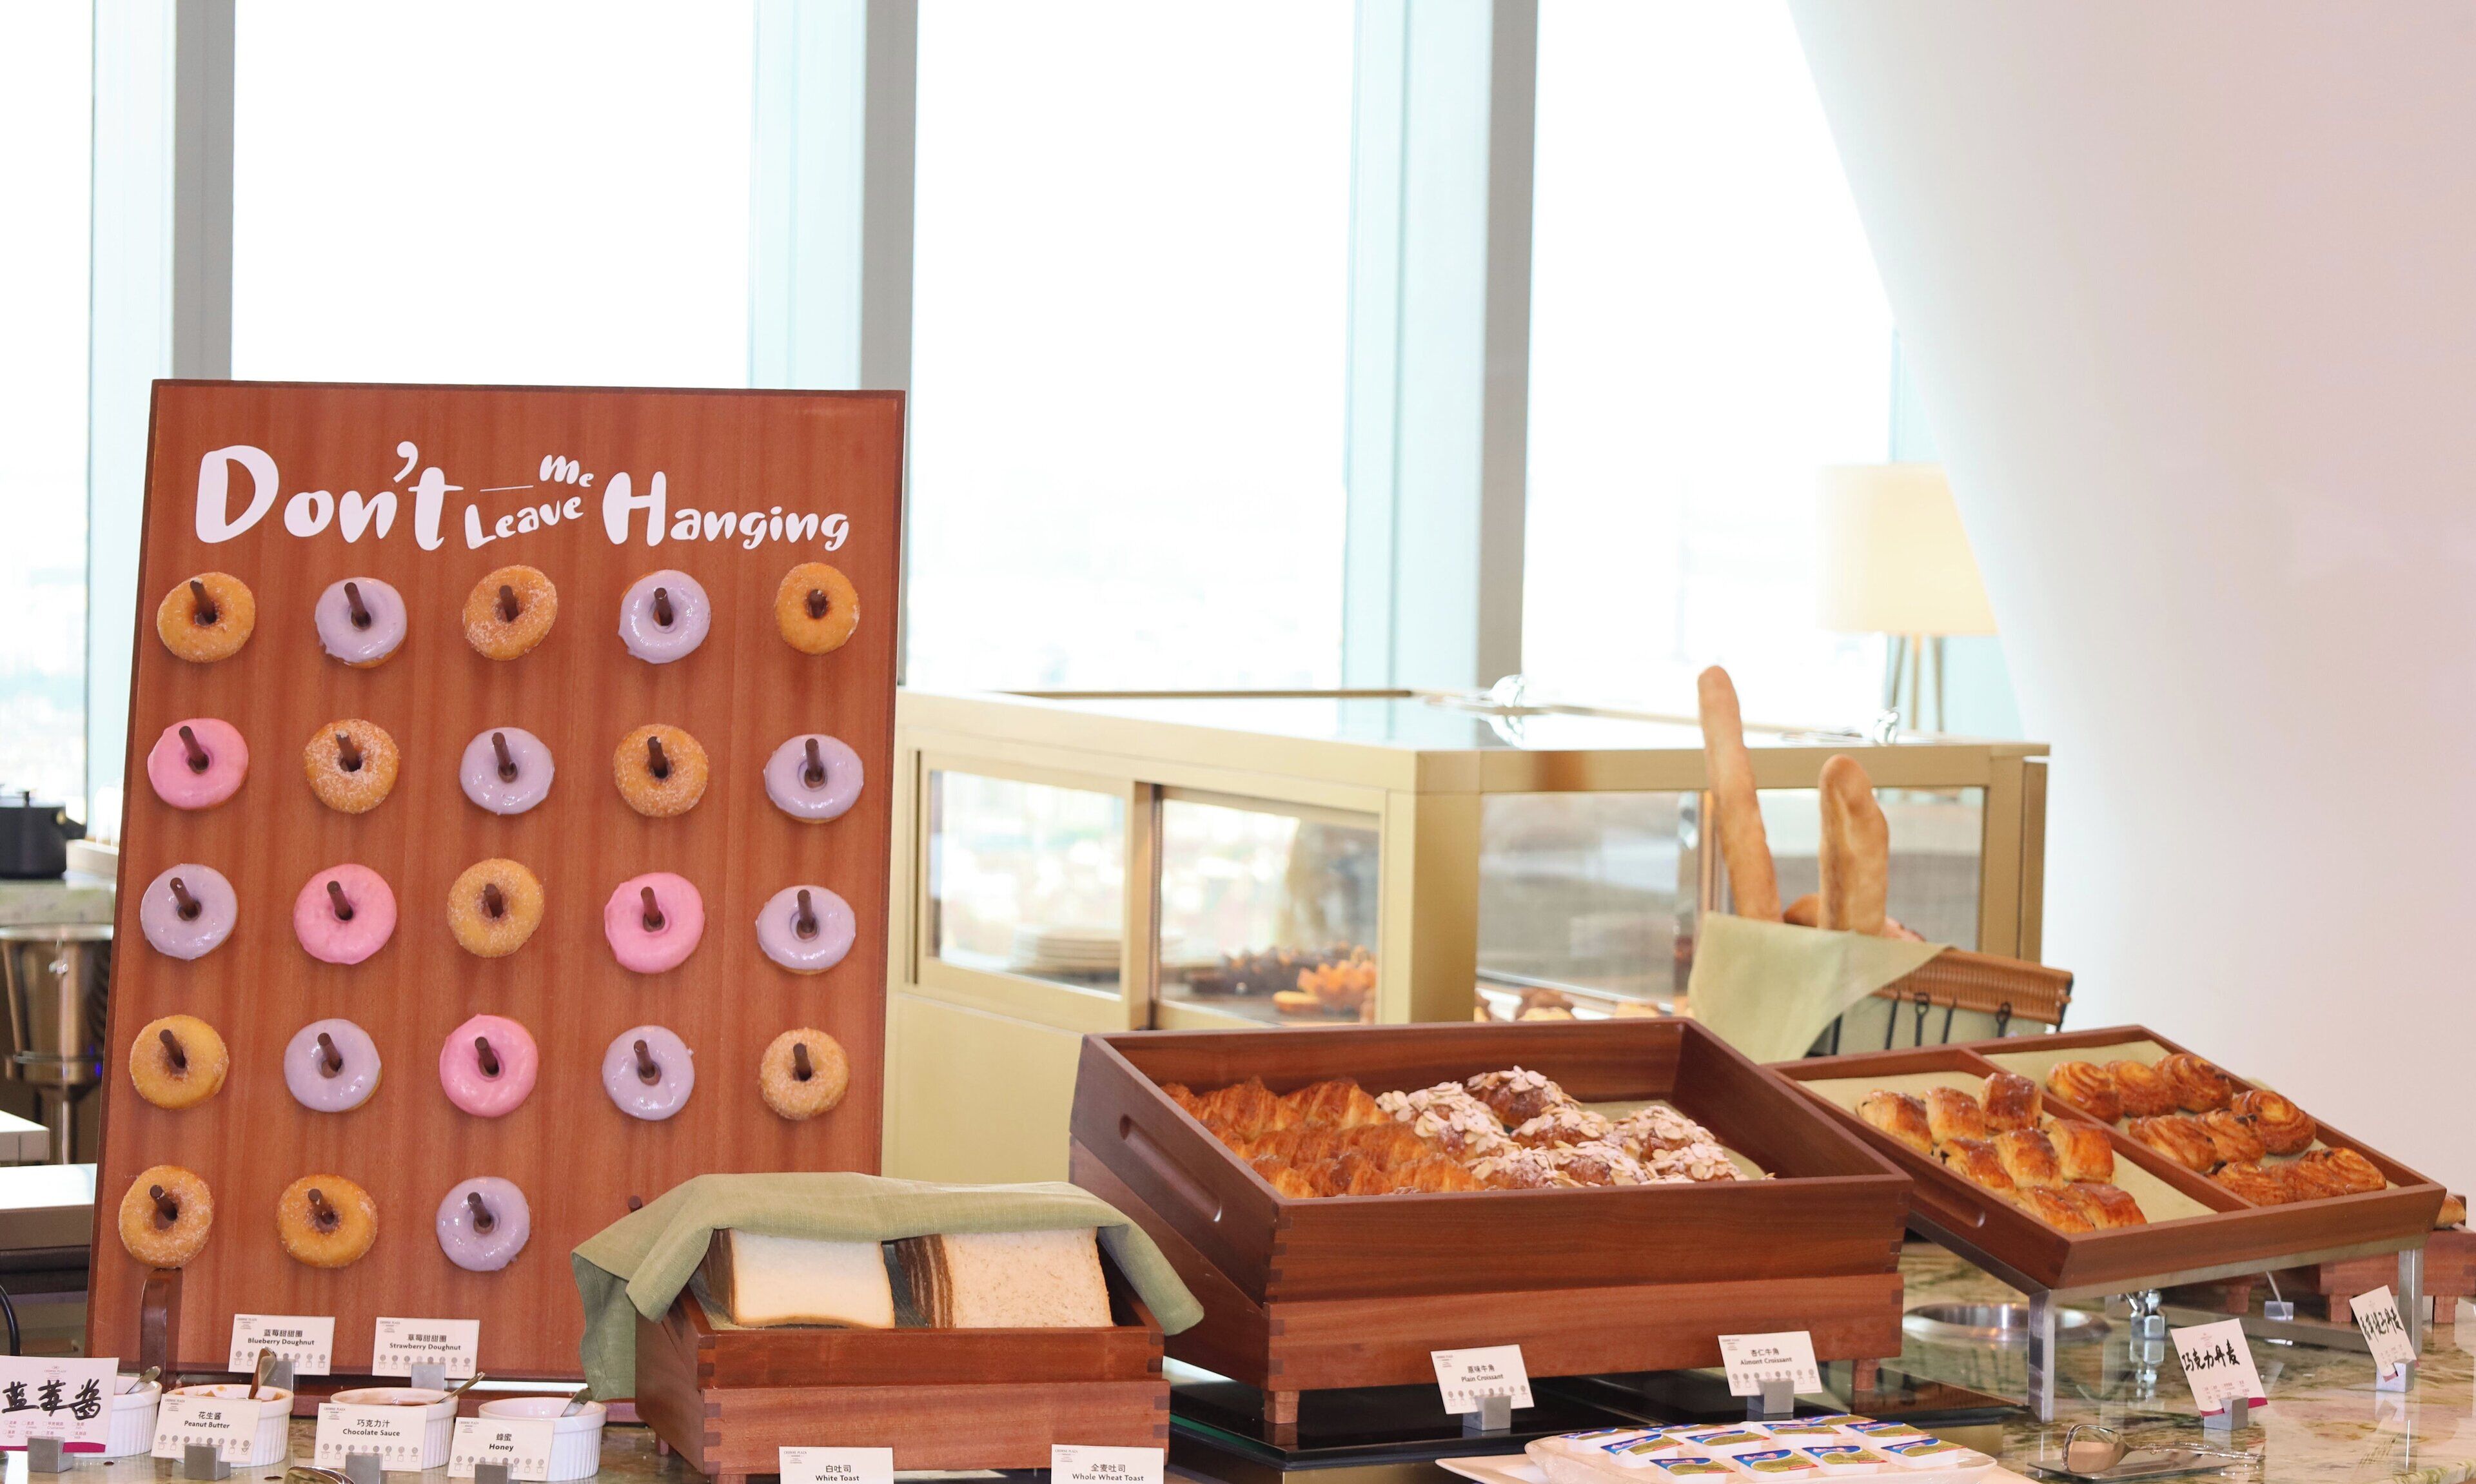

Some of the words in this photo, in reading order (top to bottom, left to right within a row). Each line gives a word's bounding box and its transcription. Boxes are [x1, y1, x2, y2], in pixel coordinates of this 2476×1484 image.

[195, 441, 464, 551] Don't
[464, 496, 584, 549] Leave
[602, 471, 849, 551] Hanging
[264, 1329, 302, 1338] 蓝莓甜甜圈
[408, 1334, 446, 1342] 草莓甜甜圈
[1751, 1347, 1780, 1357] 杏仁牛角
[2181, 1339, 2240, 1372] 巧克力丹麦
[1468, 1364, 1495, 1373] 原味牛角
[199, 1411, 221, 1420] 花生酱
[357, 1419, 390, 1428] 巧克力汁
[496, 1433, 512, 1441] 蜂蜜
[489, 1443, 514, 1452] Honey
[826, 1465, 851, 1473] 白吐司
[1091, 1464, 1126, 1472] 全麦吐司
